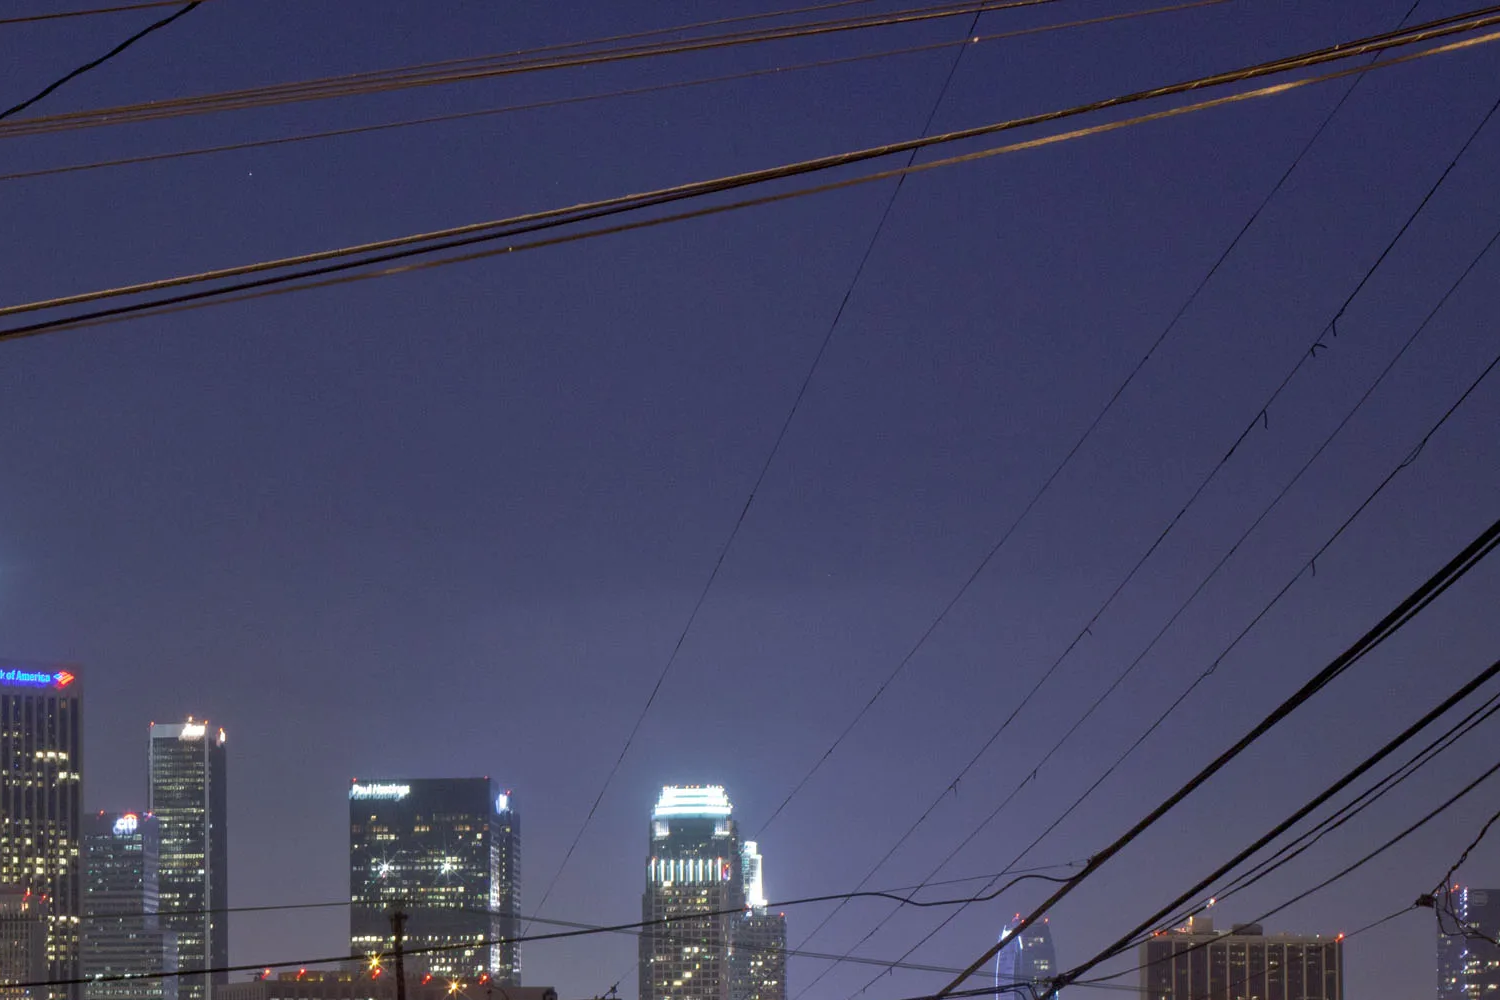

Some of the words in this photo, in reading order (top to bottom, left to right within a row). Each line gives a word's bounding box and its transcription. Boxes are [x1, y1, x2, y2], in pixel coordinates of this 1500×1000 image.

[6, 669, 16, 680] of
[16, 670, 50, 682] America
[352, 783, 372, 795] Paul
[372, 783, 410, 798] Hastings
